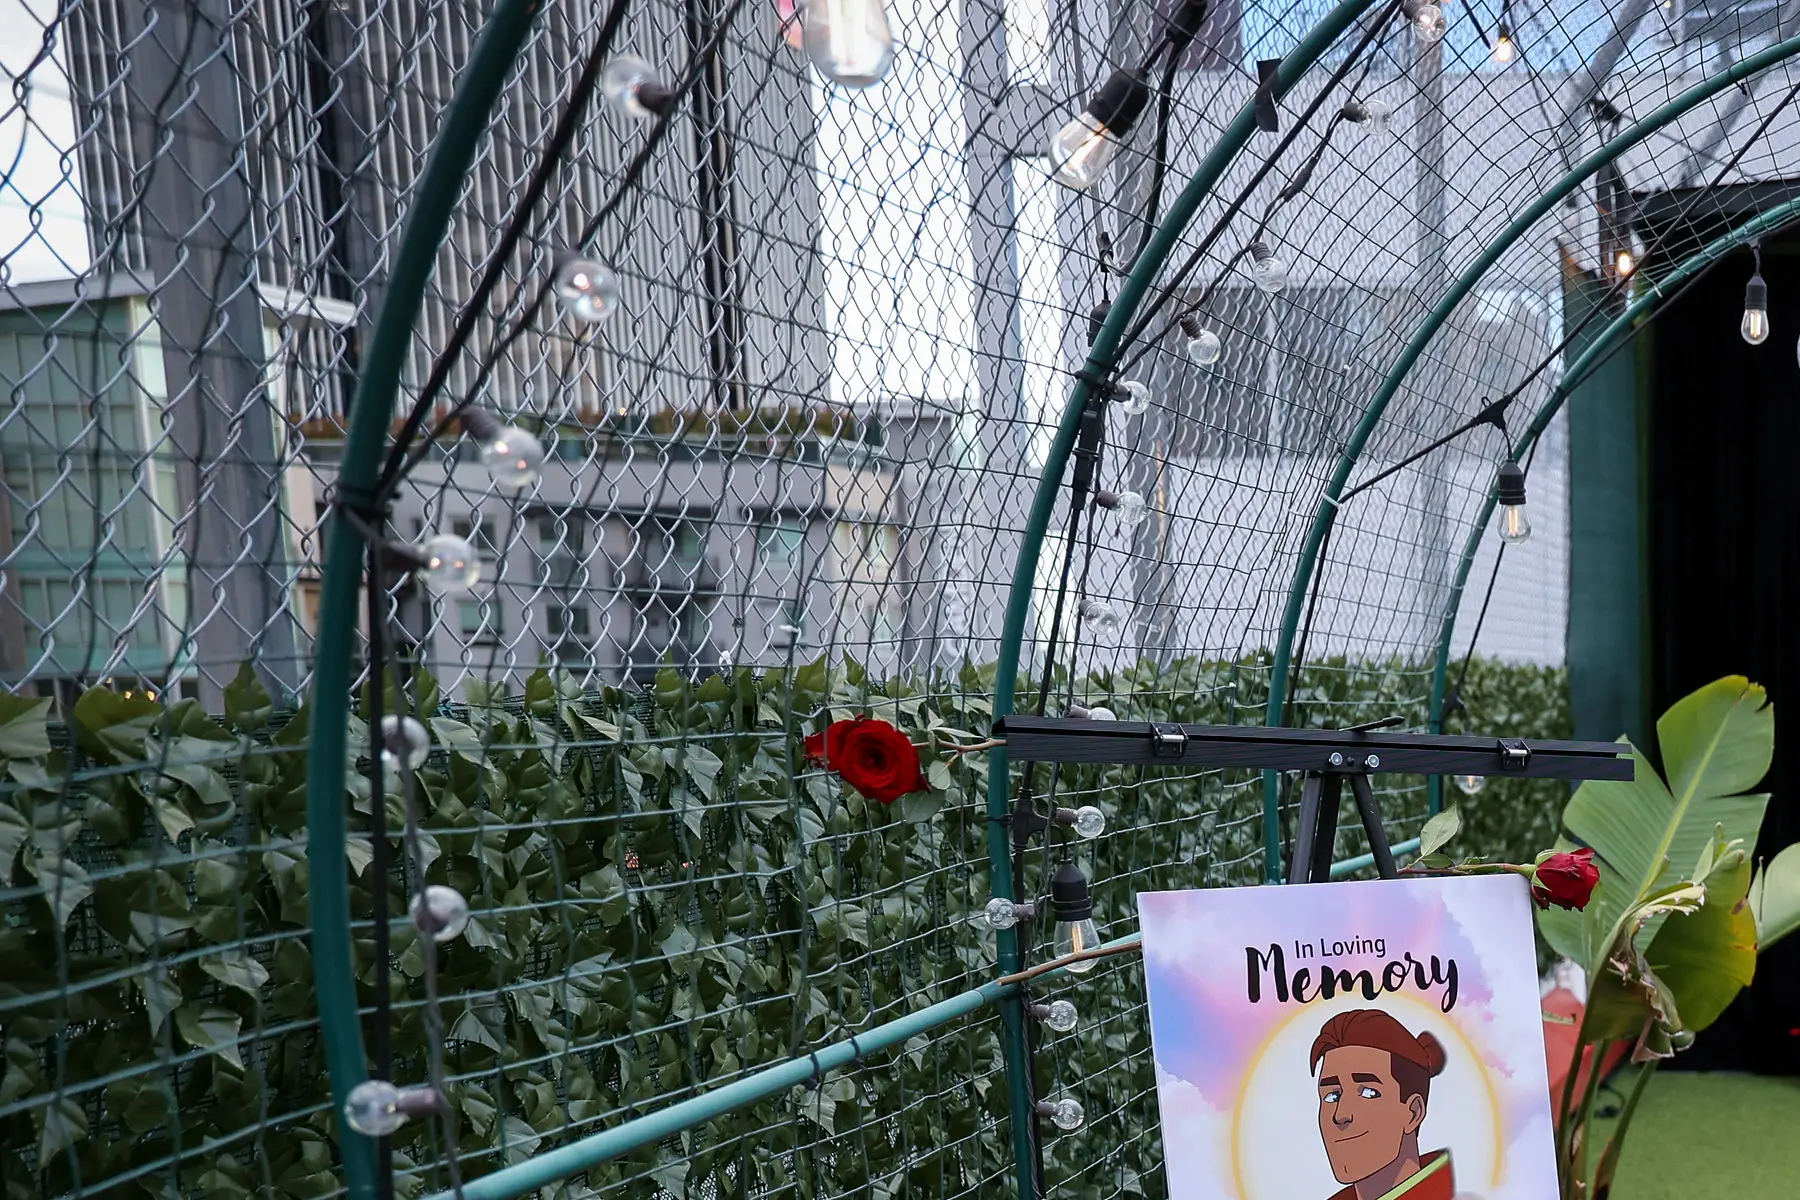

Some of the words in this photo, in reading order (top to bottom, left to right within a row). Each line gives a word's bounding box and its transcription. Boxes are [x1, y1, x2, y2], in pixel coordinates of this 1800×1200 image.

[1295, 940, 1314, 958] In
[1320, 935, 1386, 958] Loving
[1245, 943, 1458, 1013] Memory
